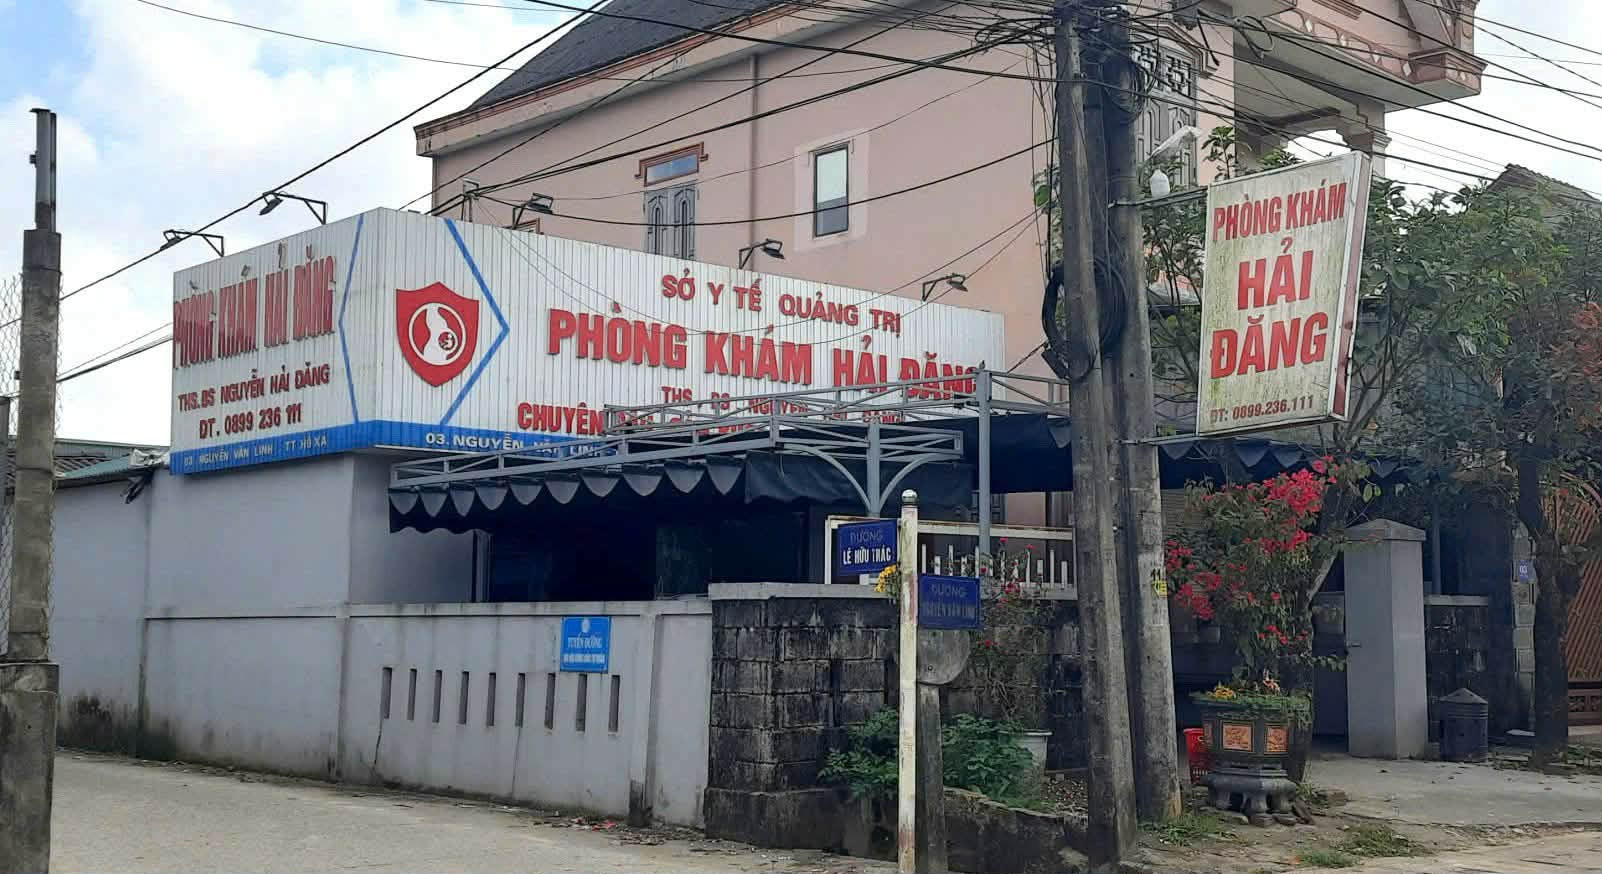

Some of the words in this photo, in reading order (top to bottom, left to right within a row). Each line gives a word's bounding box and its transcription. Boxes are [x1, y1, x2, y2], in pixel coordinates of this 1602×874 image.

[1213, 193, 1282, 241] PHÒNG
[1285, 179, 1347, 229] KHÁM
[661, 267, 697, 302] SỞ
[707, 282, 724, 306] Y
[733, 278, 763, 312] TẾ
[778, 291, 859, 327] QUẢNG
[869, 308, 901, 339] TRỊ
[1237, 236, 1314, 310] HẢI
[173, 280, 216, 370] PHÒNG
[548, 302, 688, 371] PHÒNG
[705, 323, 813, 386] KHÁM
[833, 334, 888, 396] HẢI
[1209, 311, 1329, 379] ĐĂNG
[224, 411, 254, 436] 0899
[258, 406, 281, 430] 236
[285, 402, 303, 425] 111
[517, 401, 605, 436] CHUYÊN
[1232, 394, 1314, 420] 0899.236.111
